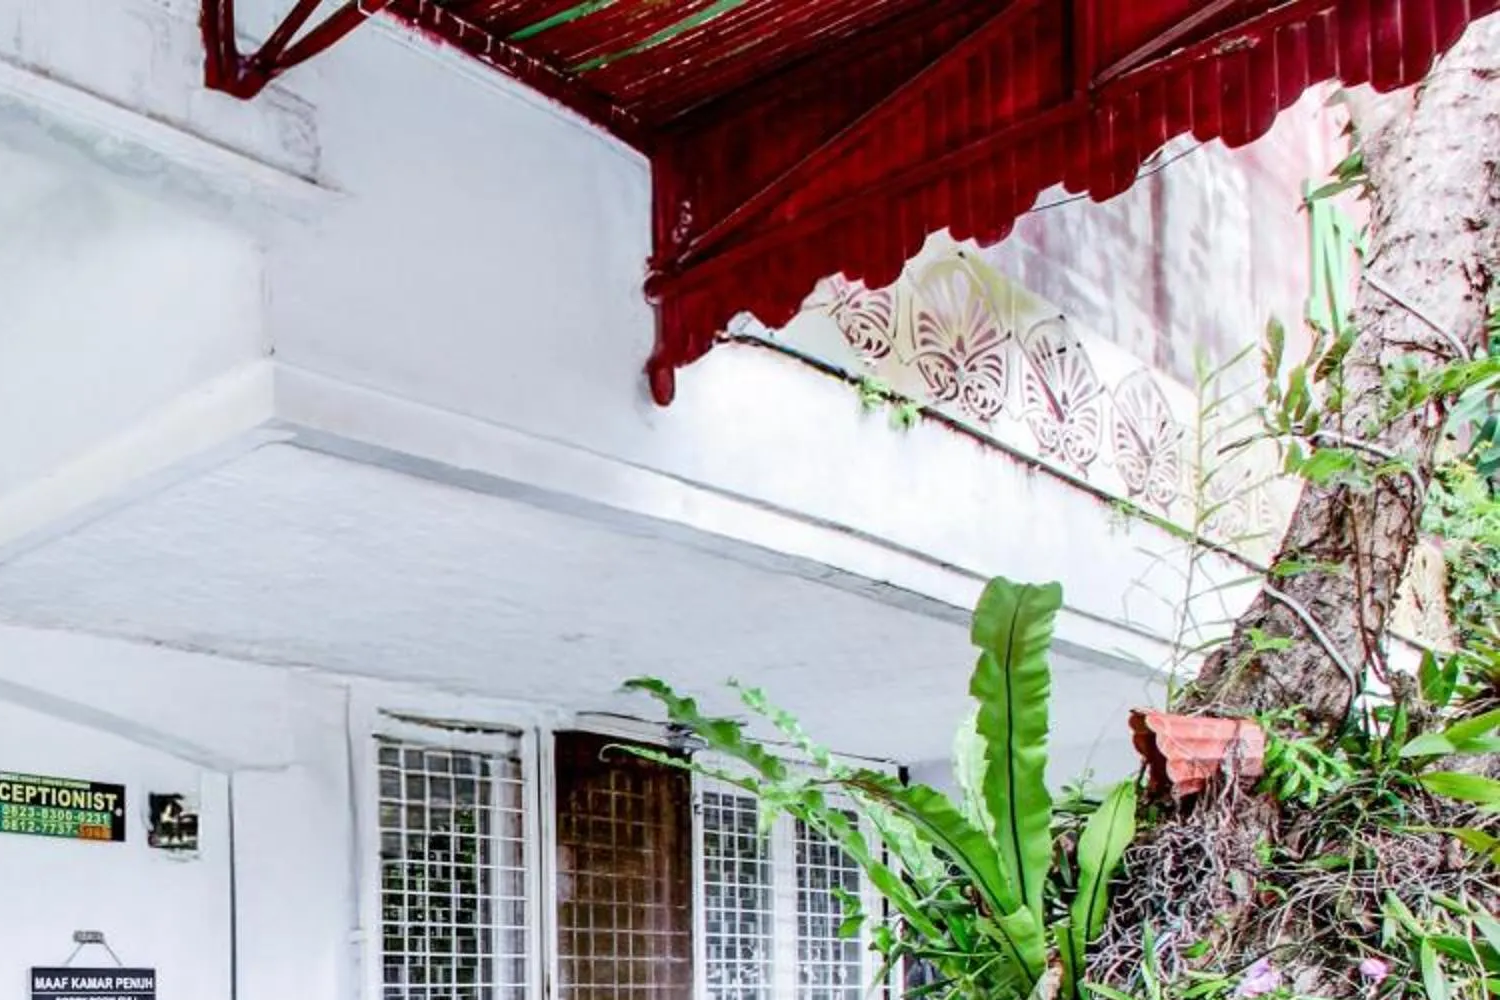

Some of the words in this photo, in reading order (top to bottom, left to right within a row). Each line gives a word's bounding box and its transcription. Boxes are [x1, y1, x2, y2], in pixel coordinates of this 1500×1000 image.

[34, 977, 68, 989] MAAF
[71, 977, 113, 989] KAMAR
[115, 978, 153, 989] PENUH
